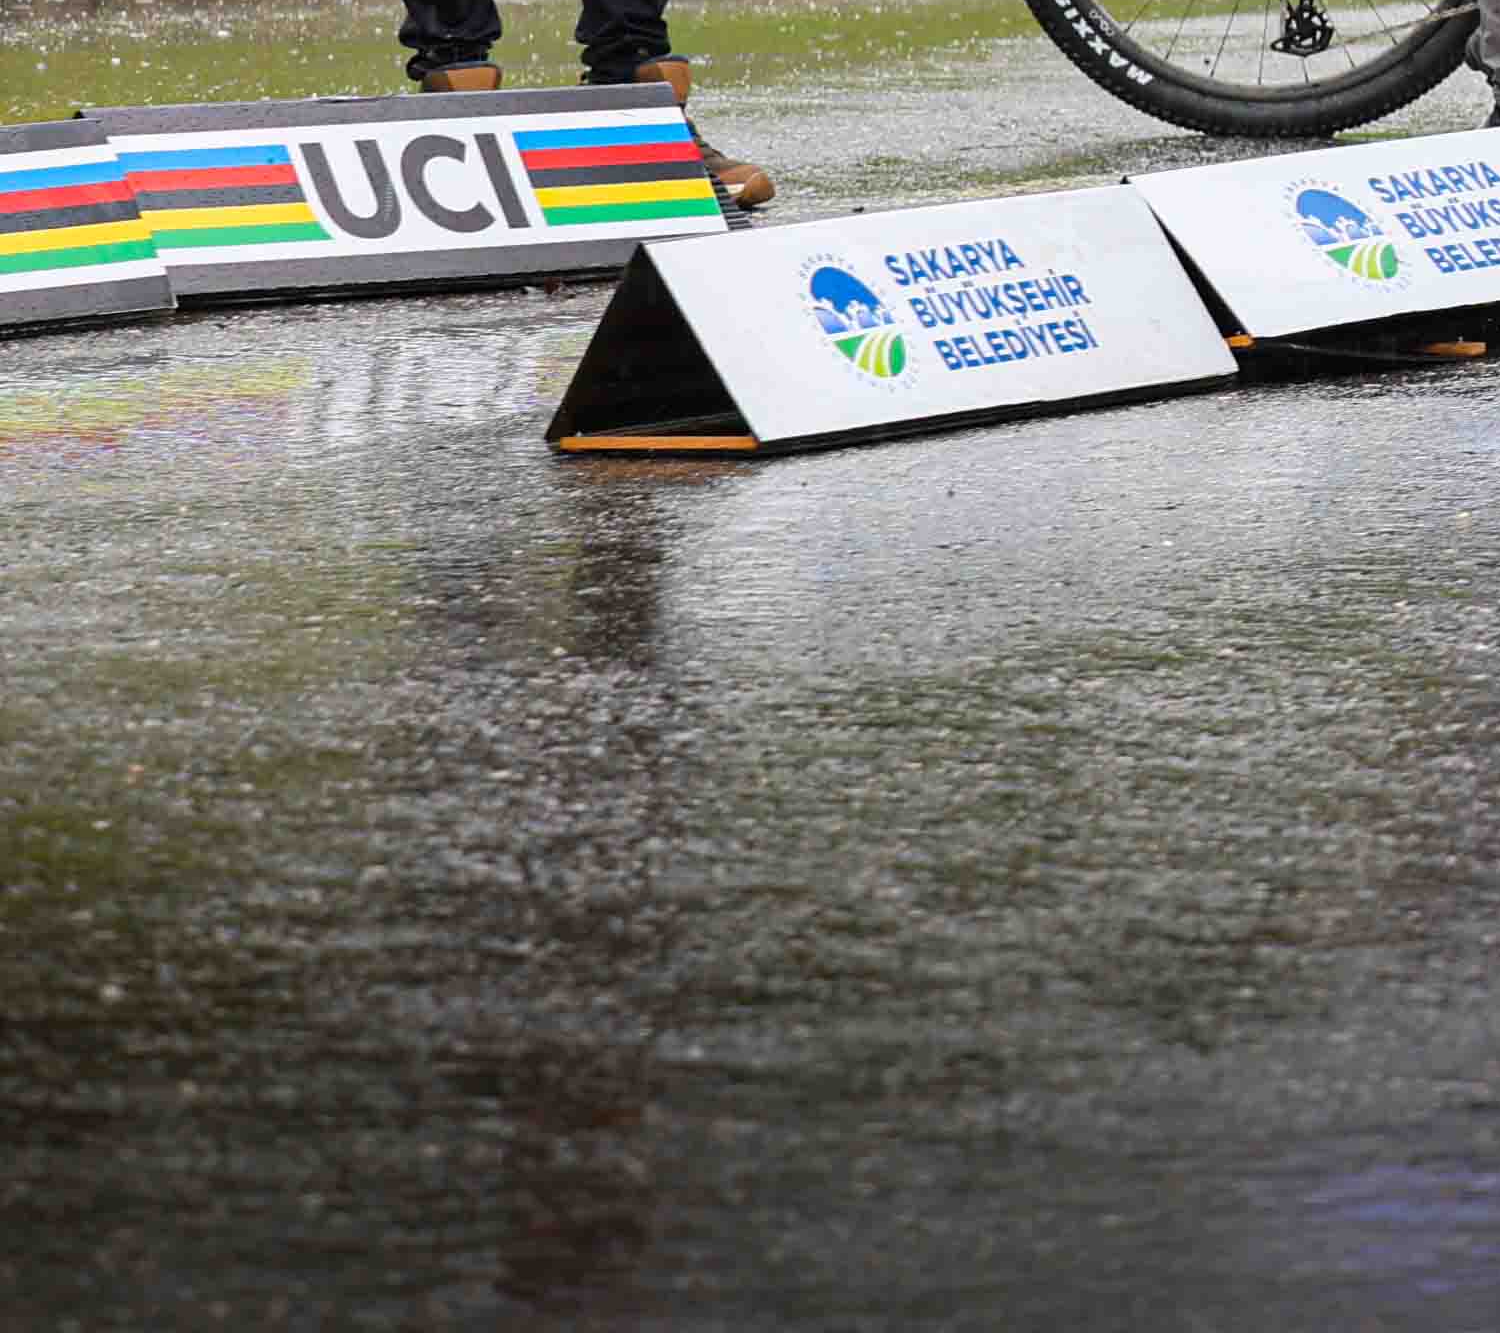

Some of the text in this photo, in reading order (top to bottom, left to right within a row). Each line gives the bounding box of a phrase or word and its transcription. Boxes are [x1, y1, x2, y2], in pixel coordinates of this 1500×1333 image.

[300, 132, 530, 239] UCI
[884, 238, 1024, 287] SAKARYA
[908, 269, 1092, 330] BÜYÜKŞEHİR
[933, 309, 1101, 372] BELEDİYESİ
